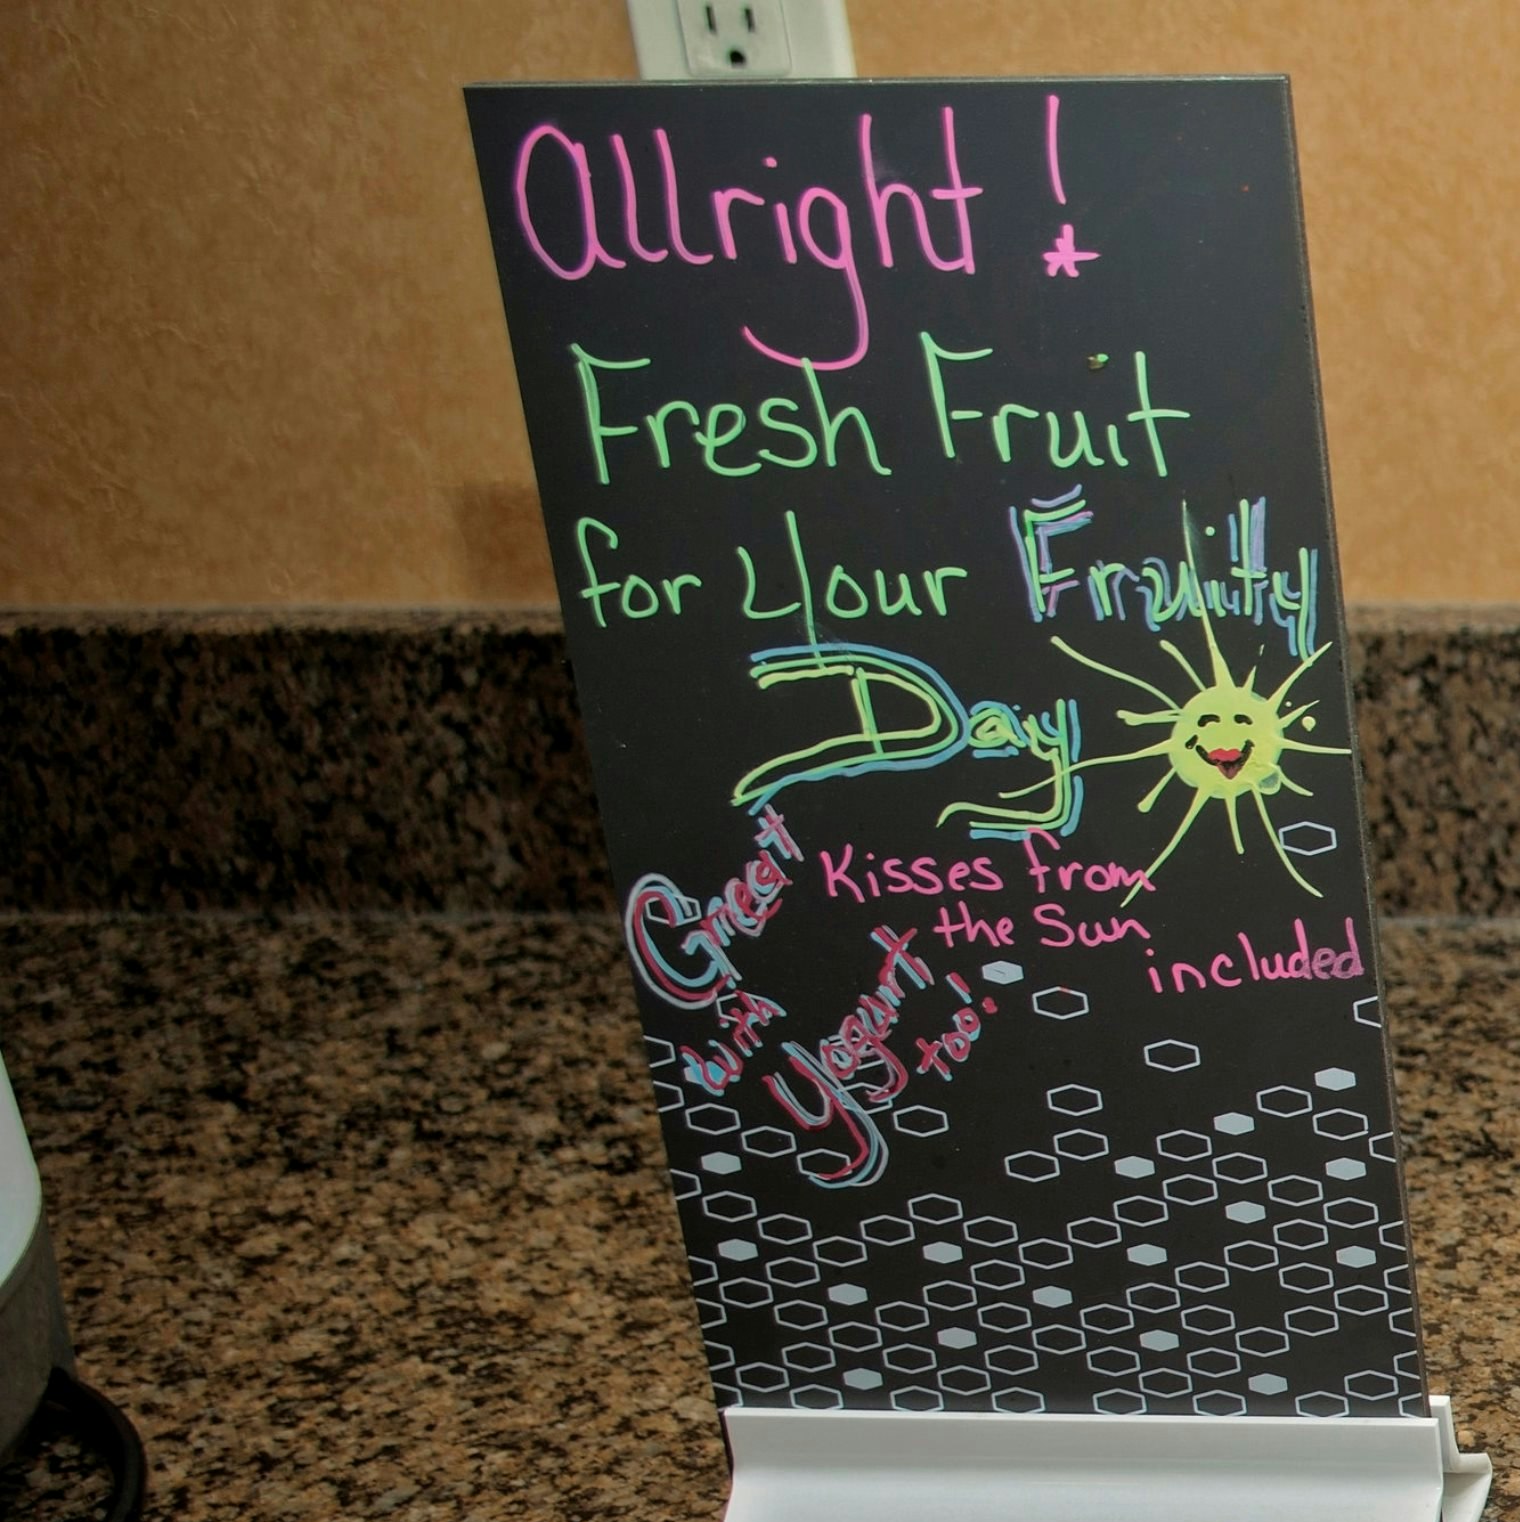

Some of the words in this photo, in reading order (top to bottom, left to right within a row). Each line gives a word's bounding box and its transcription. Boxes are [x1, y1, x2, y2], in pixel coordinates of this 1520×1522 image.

[570, 342, 892, 486] Fresh
[921, 331, 1191, 478] Fruit
[575, 516, 703, 628] for
[731, 640, 1083, 840] Day
[624, 803, 804, 1009] Great
[818, 843, 1004, 903] Kisses
[1019, 827, 1156, 895] from
[933, 900, 1015, 949] the
[1039, 903, 1152, 949] Sun
[1144, 917, 1366, 995] included
